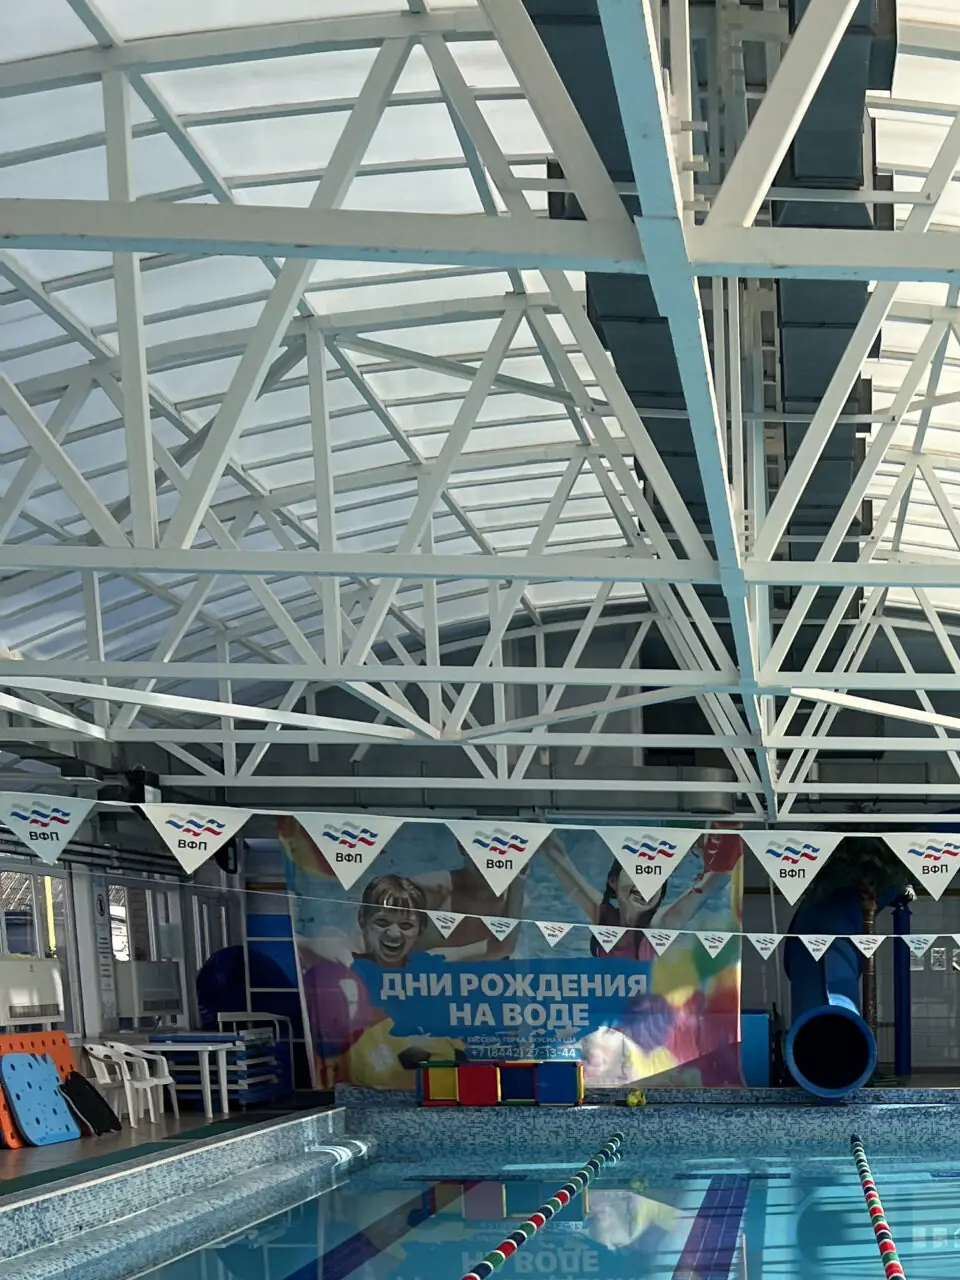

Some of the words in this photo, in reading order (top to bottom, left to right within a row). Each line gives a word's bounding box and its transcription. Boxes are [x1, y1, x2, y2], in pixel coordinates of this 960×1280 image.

[29, 831, 60, 842] ВФП
[177, 839, 208, 851] ВФП
[336, 852, 363, 864] ВФП
[486, 858, 513, 870] ВФП
[635, 864, 662, 876] ВФП
[779, 868, 806, 879] ВФП
[922, 864, 949, 875] ВФП
[380, 973, 452, 1001] ДНИ
[459, 973, 647, 1001] РОЖДЕНИЯ
[450, 1003, 496, 1026] НА
[503, 1003, 590, 1031] ВОДЕ
[472, 1048, 484, 1057] +7
[526, 1047, 576, 1057] 27-13-44
